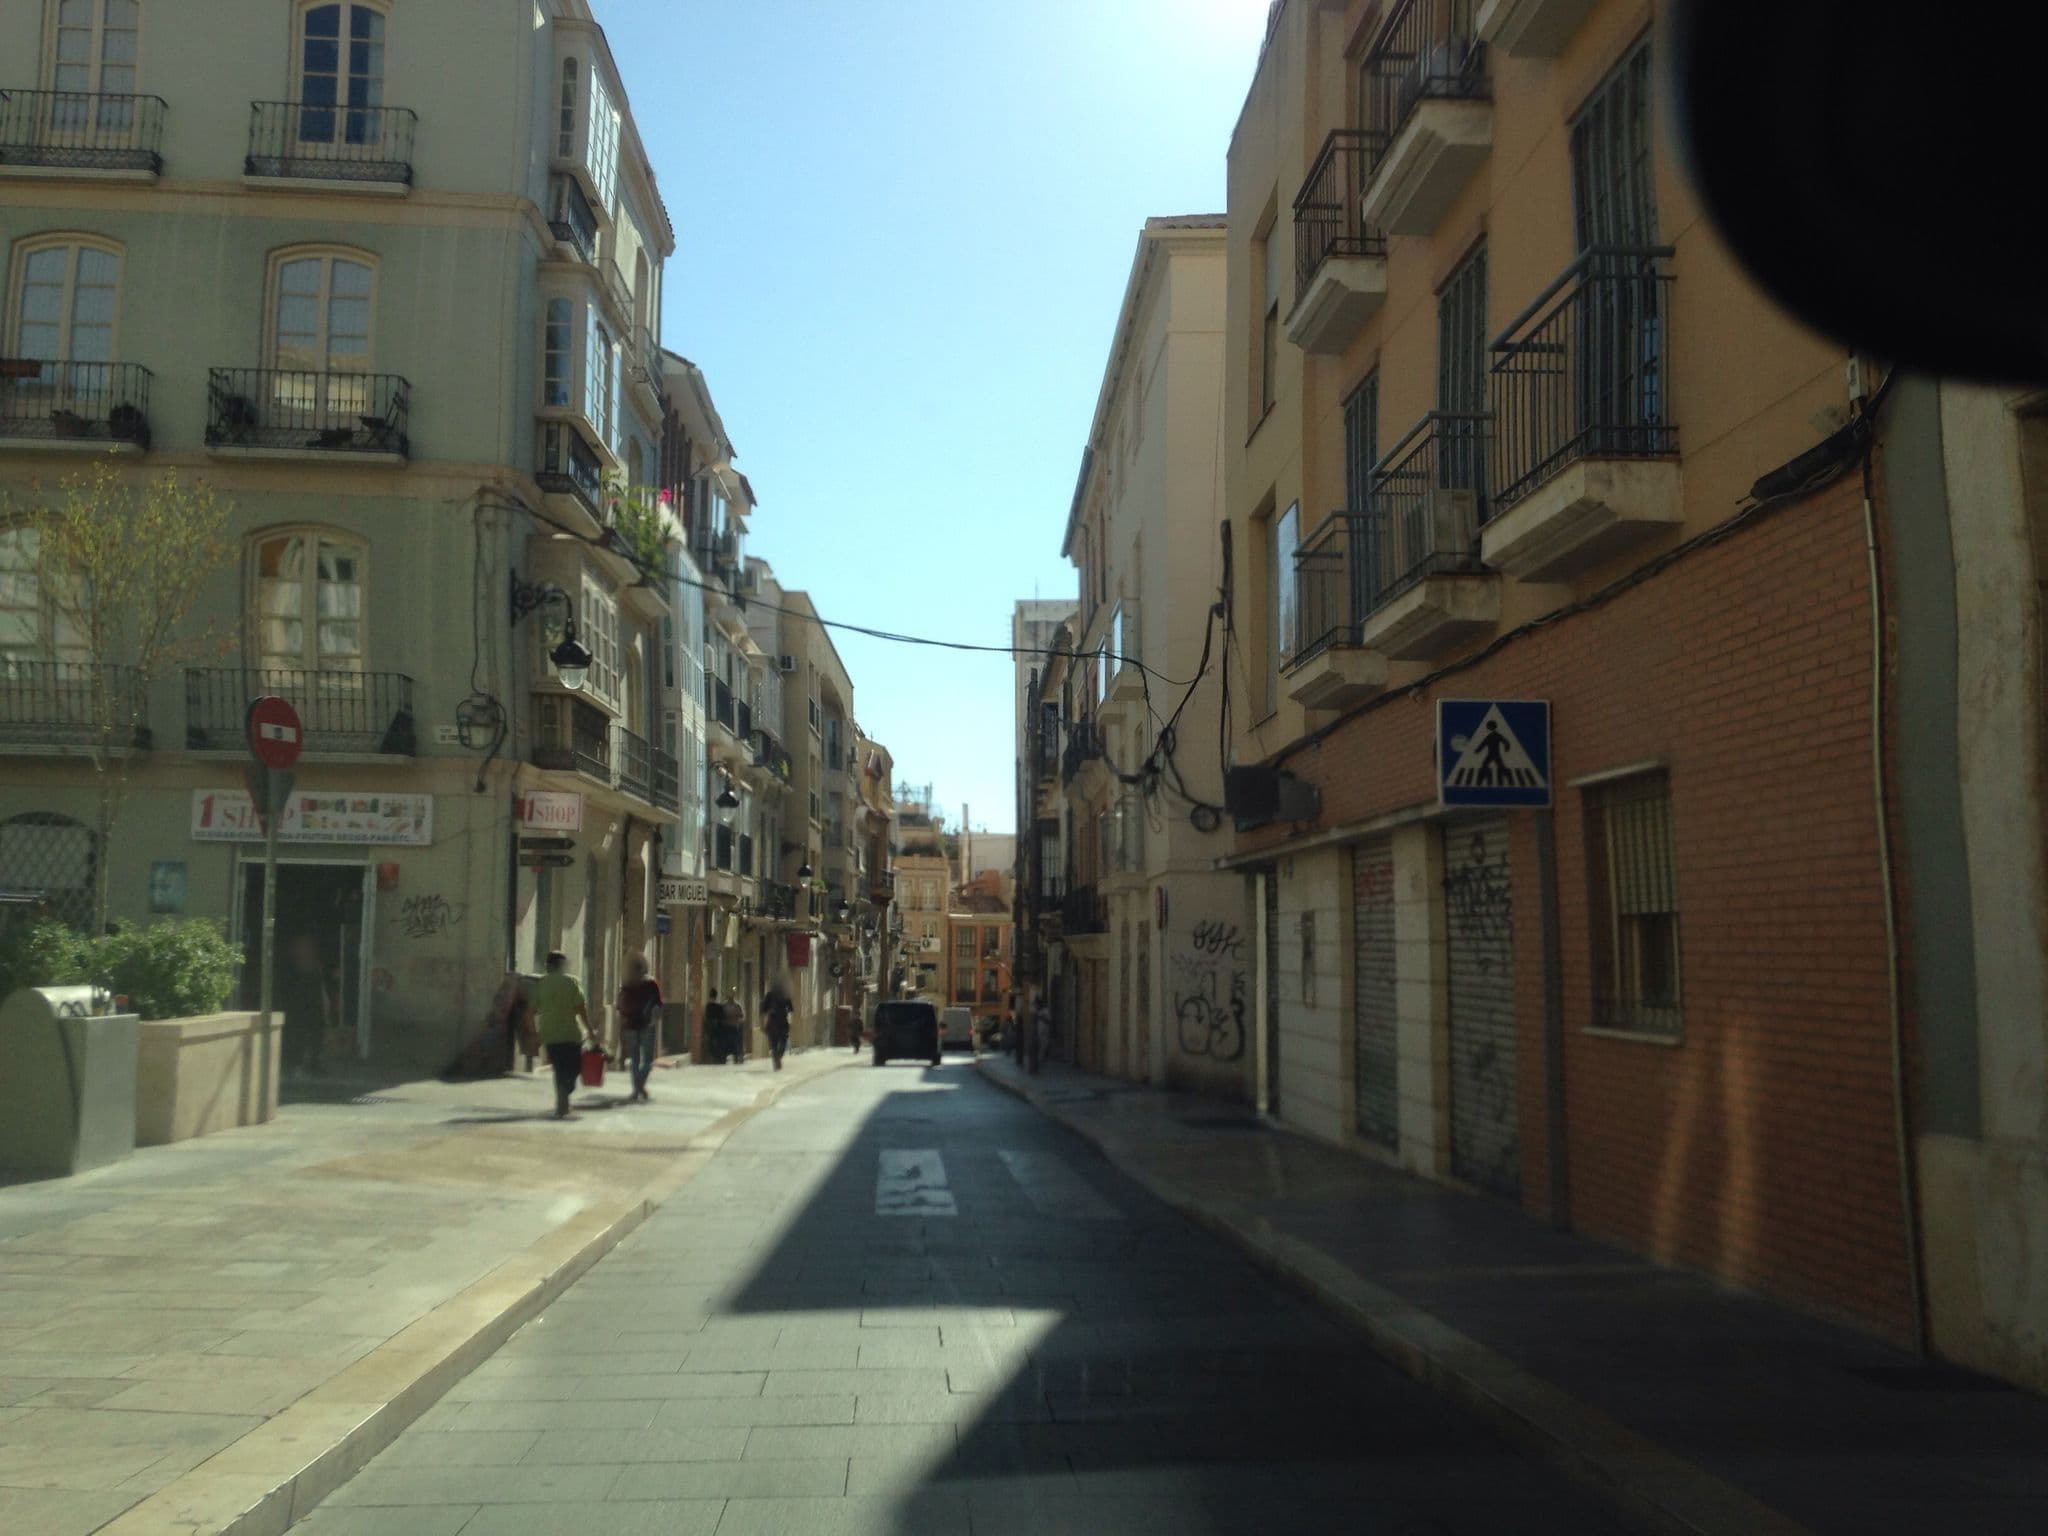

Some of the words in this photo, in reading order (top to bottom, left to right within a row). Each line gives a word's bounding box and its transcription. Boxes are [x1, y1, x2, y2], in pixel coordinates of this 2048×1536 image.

[200, 794, 215, 828] 1
[221, 806, 294, 829] SHP
[536, 806, 576, 823] SHOP
[659, 884, 675, 899] BAR
[678, 884, 706, 901] MIGUEL
